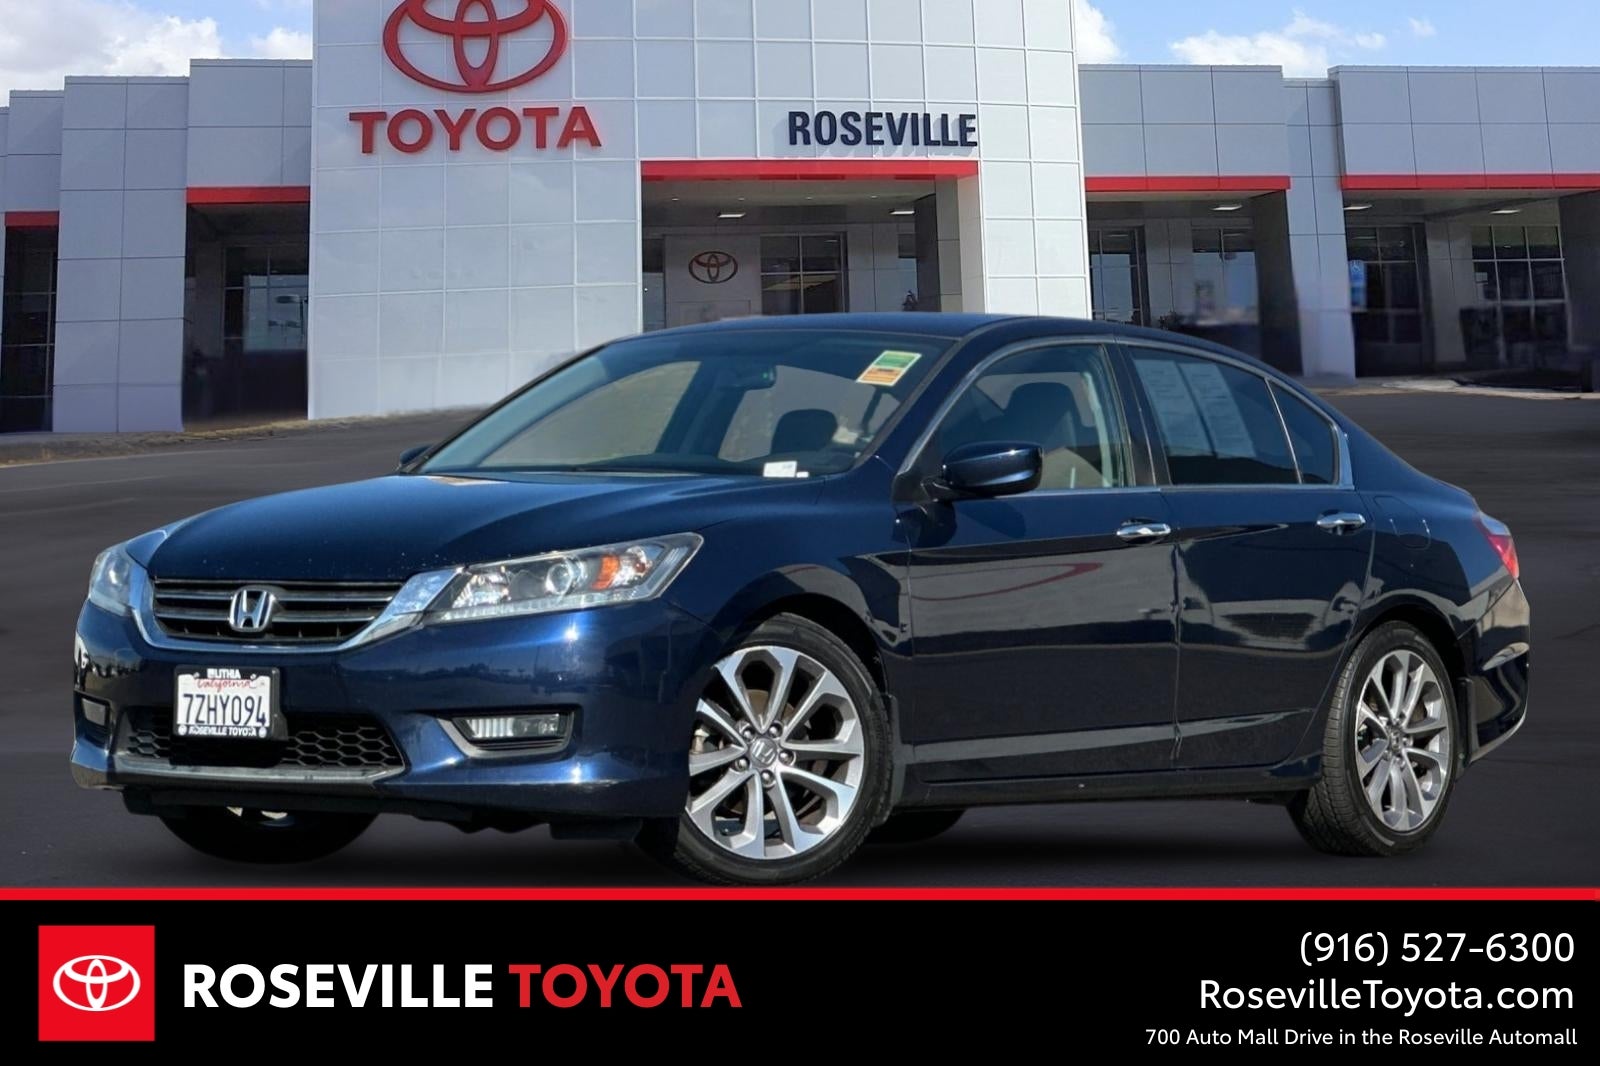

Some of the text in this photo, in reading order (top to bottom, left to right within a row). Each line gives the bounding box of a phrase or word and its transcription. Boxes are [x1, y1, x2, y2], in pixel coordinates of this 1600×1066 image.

[348, 106, 602, 154] TOYOTA
[788, 110, 978, 148] ROSEVILLE
[214, 668, 241, 679] LITHIA
[197, 679, 257, 692] California
[183, 693, 267, 726] 7ZHY094
[188, 726, 257, 737] ROSEVILLE TOYOTA
